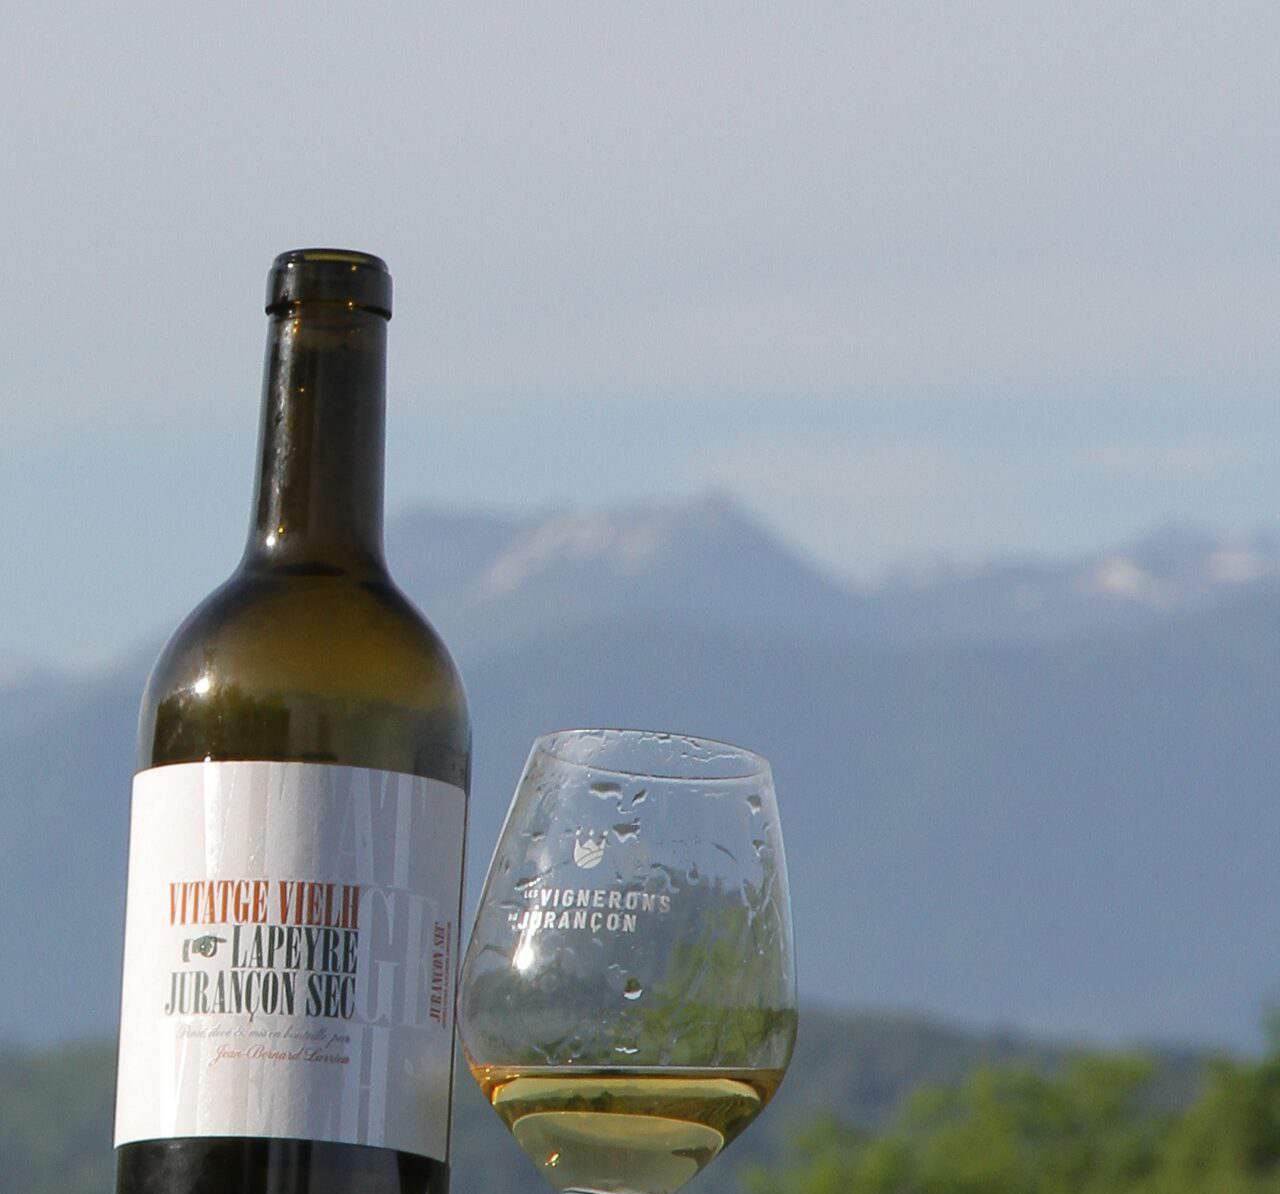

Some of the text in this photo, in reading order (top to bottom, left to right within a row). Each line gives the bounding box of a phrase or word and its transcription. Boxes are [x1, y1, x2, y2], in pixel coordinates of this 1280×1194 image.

[169, 880, 360, 929] VITATGE VIELH
[517, 910, 637, 933] JURANÇON
[540, 888, 670, 912] VIGNERONS
[231, 925, 360, 974] LAPEYRE
[165, 970, 356, 1022] JURANÇON SEC
